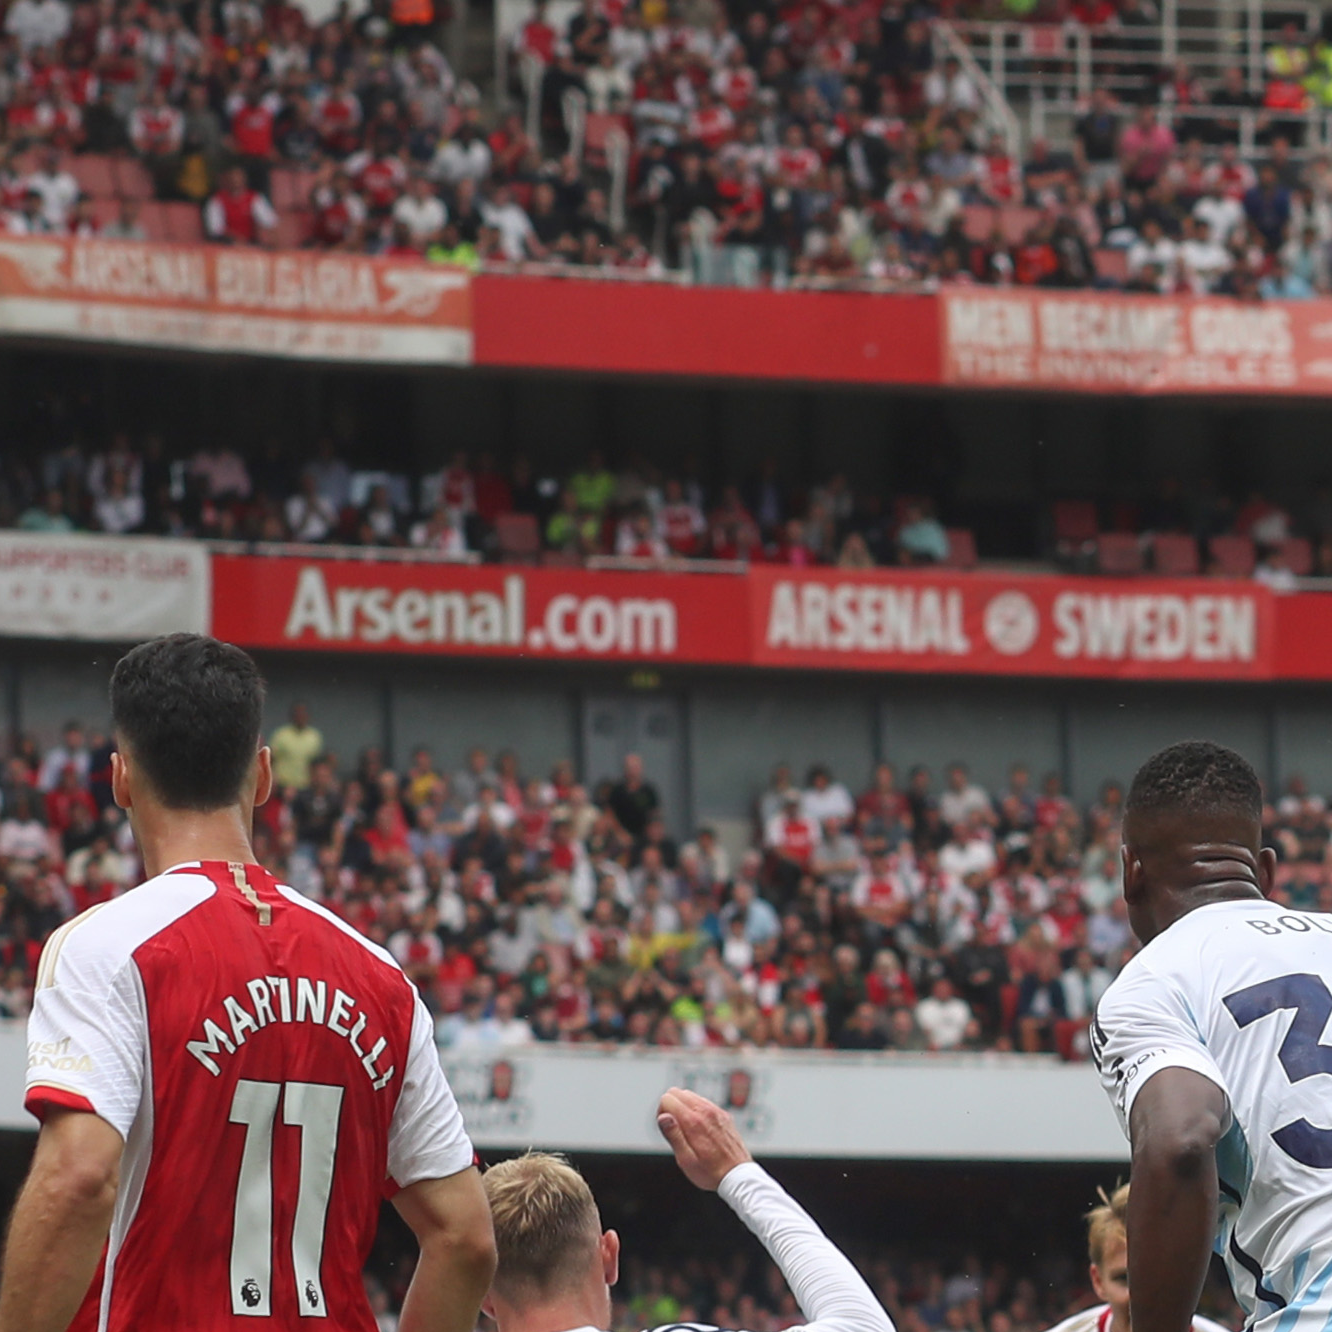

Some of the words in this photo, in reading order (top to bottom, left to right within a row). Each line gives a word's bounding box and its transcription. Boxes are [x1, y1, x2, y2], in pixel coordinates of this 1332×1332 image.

[72, 244, 207, 298] ARSENAL
[215, 251, 380, 312] BULGARIA
[948, 298, 1034, 349] MEN
[1041, 301, 1185, 354] BECAME
[1189, 304, 1293, 356] GODS
[955, 350, 1032, 381] THE
[135, 549, 191, 581] CLUB
[284, 565, 678, 655] Arsenal.com
[767, 580, 971, 657] ARSENAL
[1053, 591, 1257, 663] SWEDEN
[185, 975, 396, 1092] MARTINELLI
[228, 1078, 346, 1318] 11
